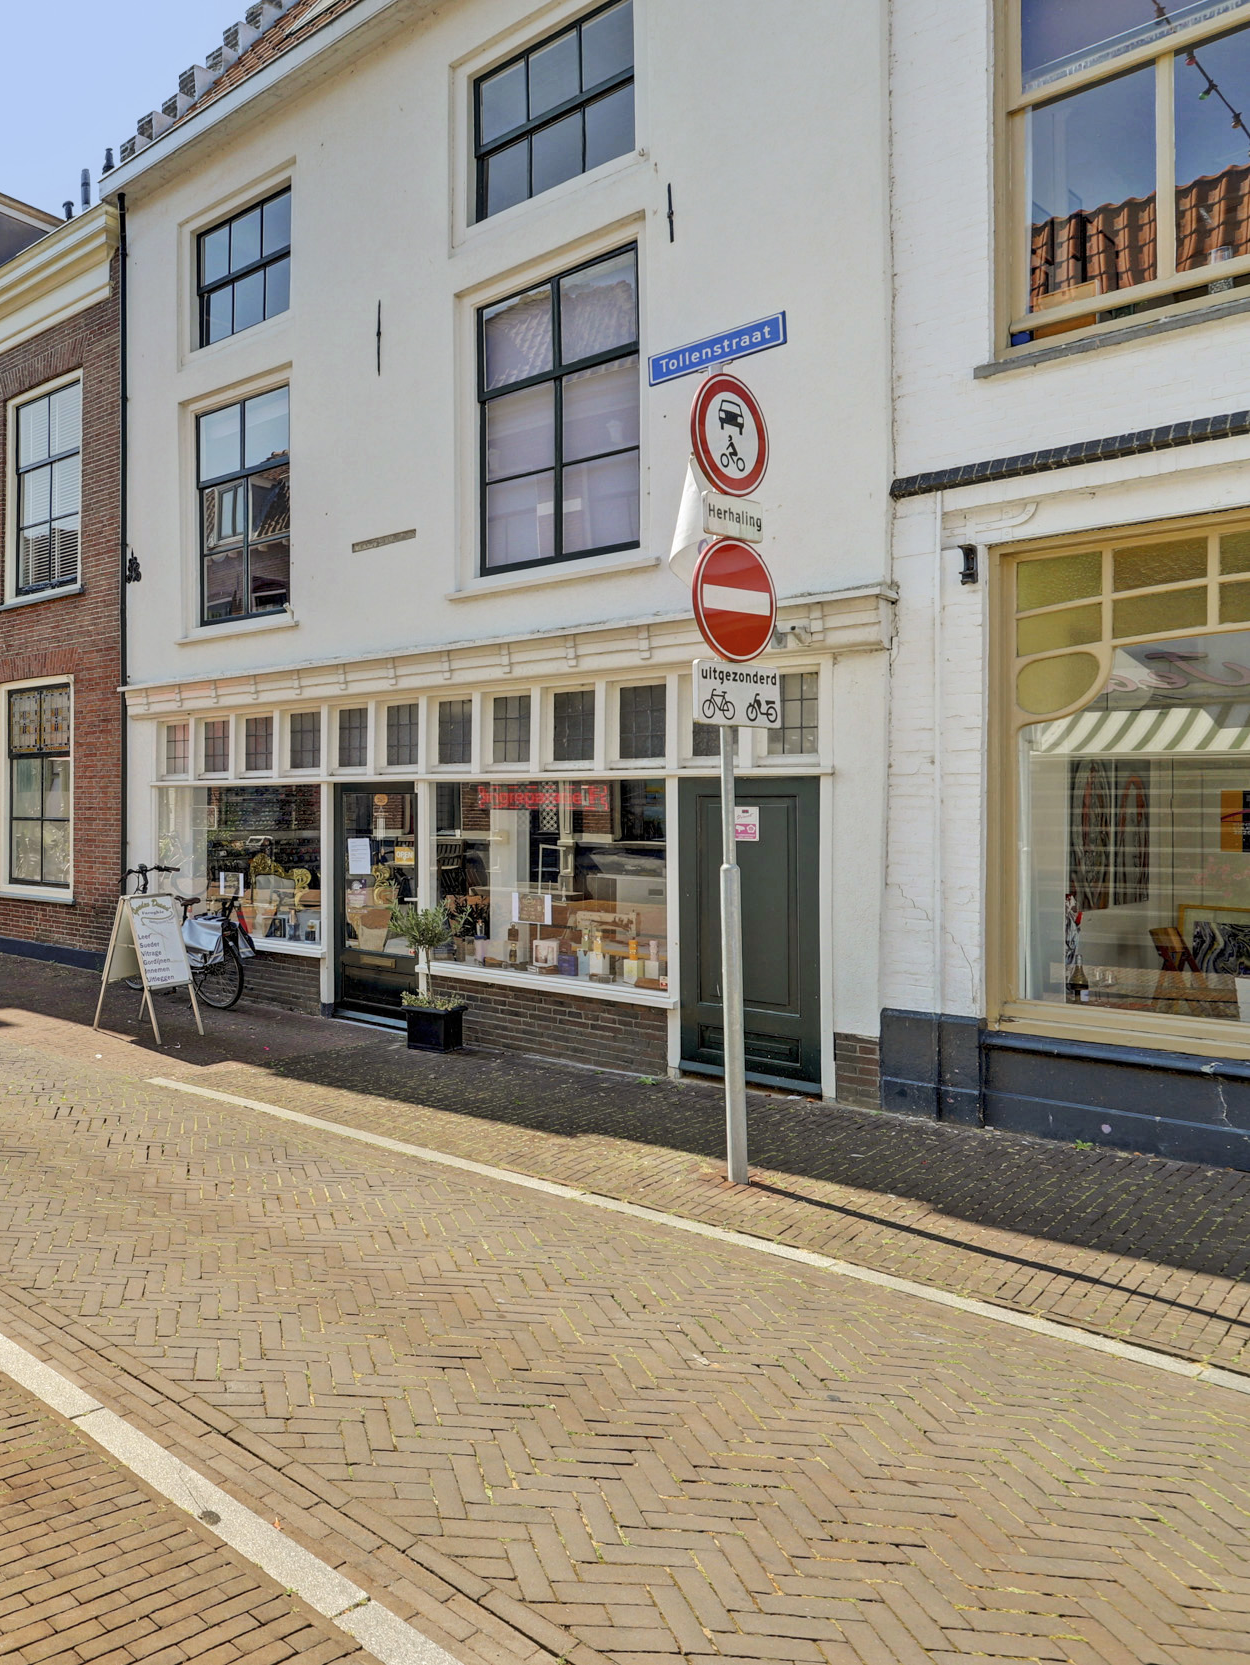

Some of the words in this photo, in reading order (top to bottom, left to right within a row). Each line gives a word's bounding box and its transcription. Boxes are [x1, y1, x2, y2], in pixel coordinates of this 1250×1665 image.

[659, 325, 771, 373] Tollenstraat
[708, 502, 762, 532] Herhaling
[701, 666, 777, 685] uitgezonderd
[396, 851, 414, 859] OPEN
[143, 958, 171, 966] Gordijnen
